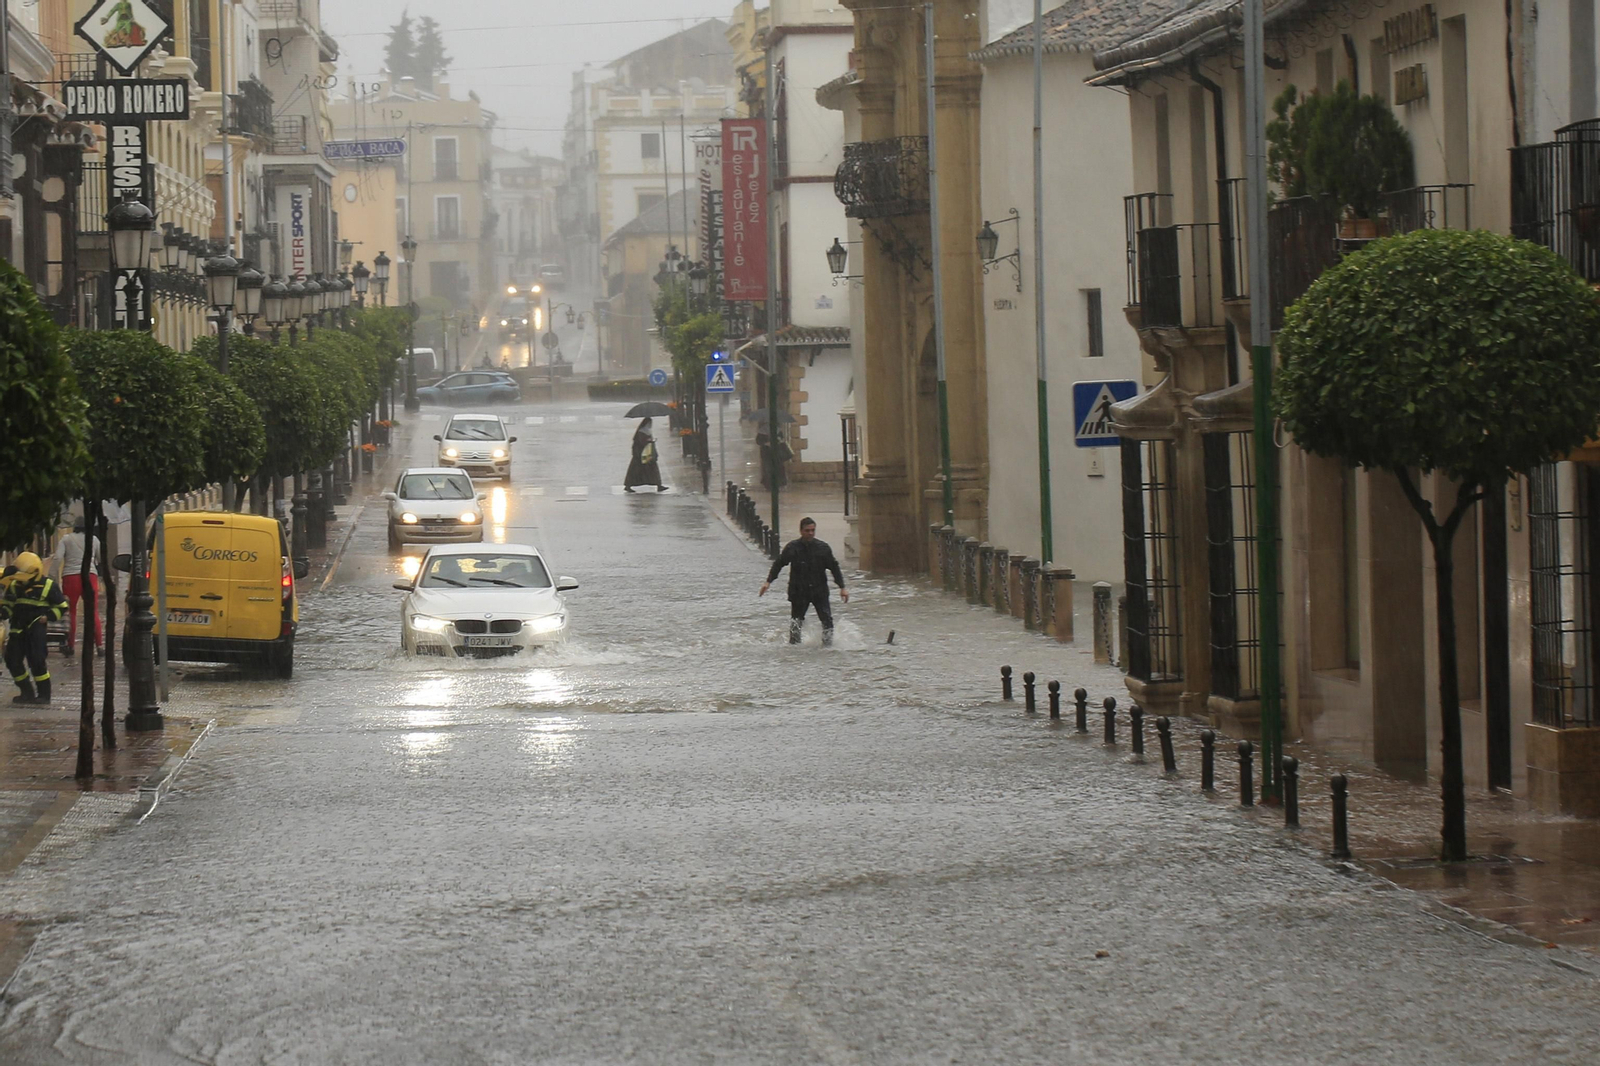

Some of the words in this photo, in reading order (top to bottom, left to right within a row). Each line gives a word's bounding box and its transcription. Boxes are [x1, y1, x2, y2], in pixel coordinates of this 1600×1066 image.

[66, 85, 116, 115] PEDRO
[123, 84, 185, 114] ROMERO
[369, 141, 401, 155] BACA
[695, 144, 722, 158] HOT
[193, 545, 258, 562] CORREOS
[167, 614, 190, 623] 4127
[470, 637, 491, 646] 0241
